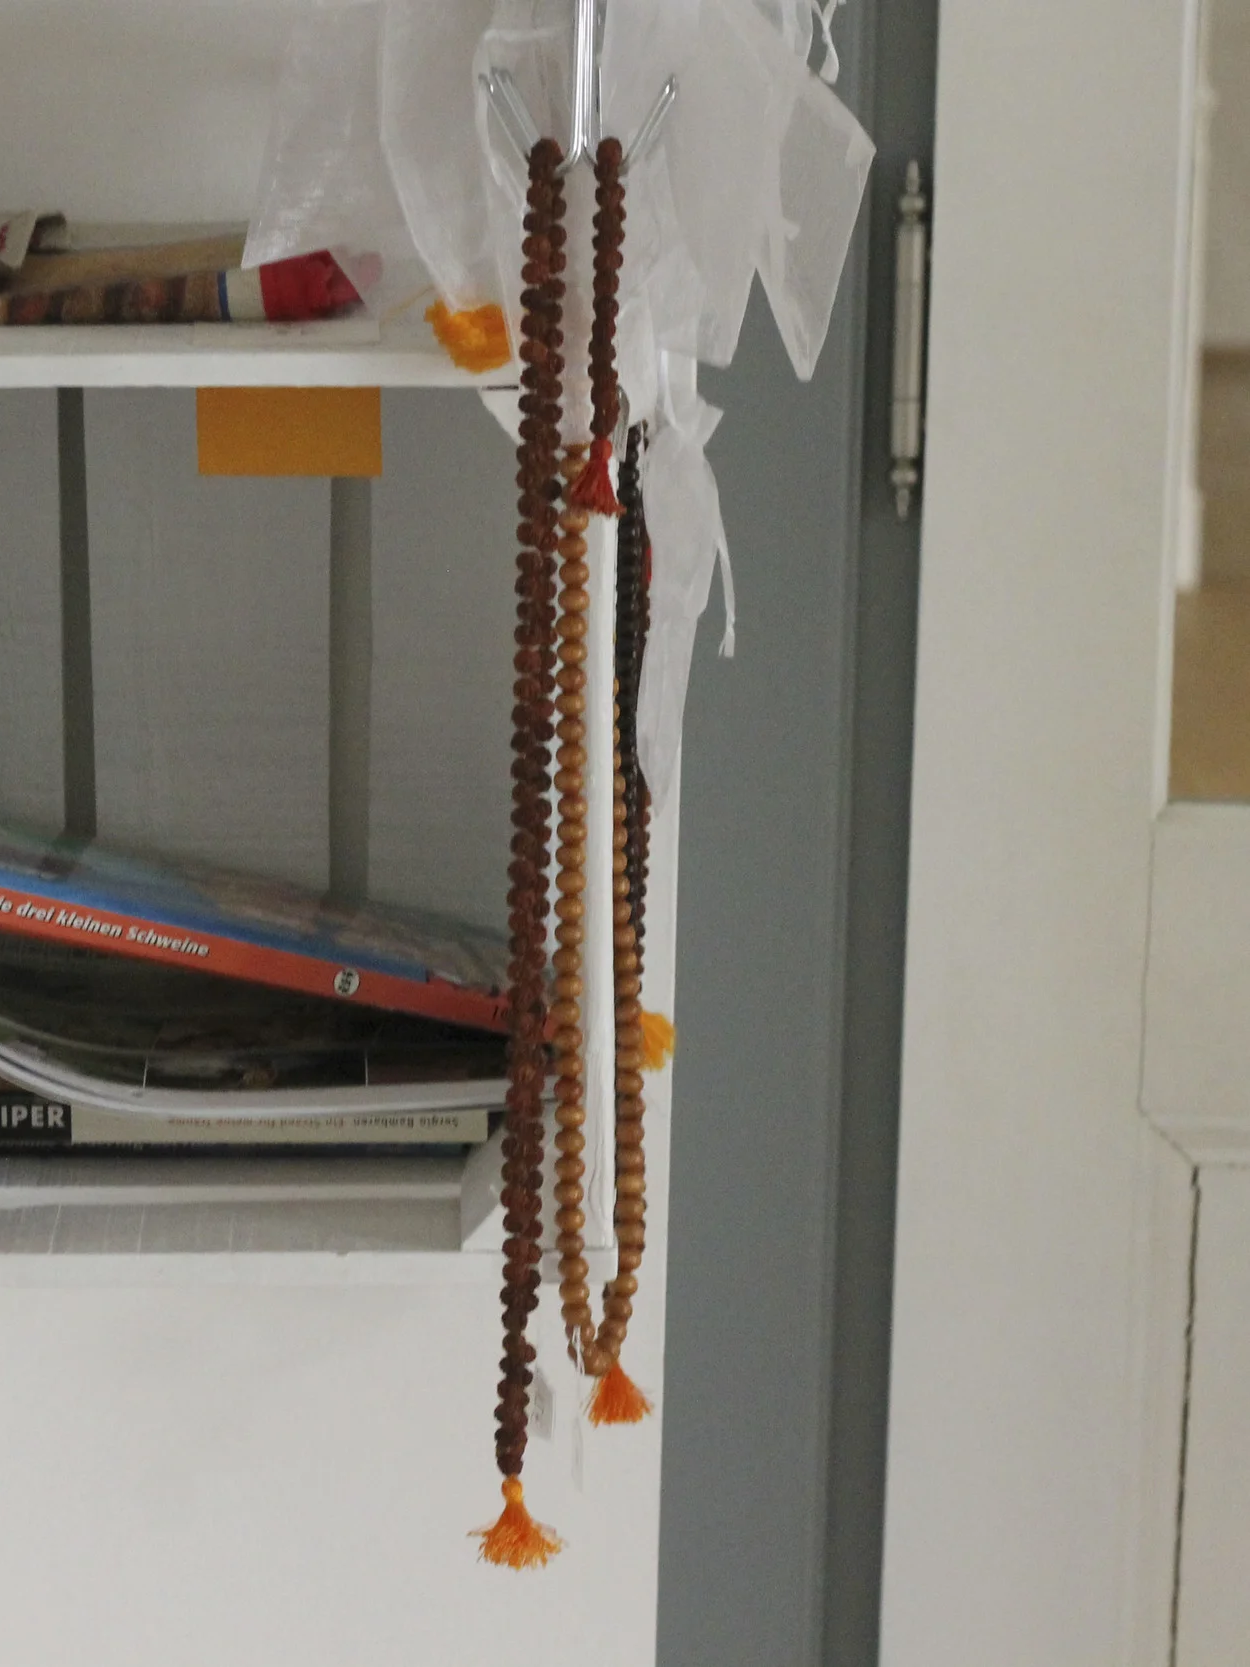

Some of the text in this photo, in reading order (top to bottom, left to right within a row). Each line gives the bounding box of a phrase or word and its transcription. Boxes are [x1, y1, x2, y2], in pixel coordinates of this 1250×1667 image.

[15, 901, 53, 923] drei
[55, 907, 124, 939] kleinen
[125, 924, 211, 959] Schweine
